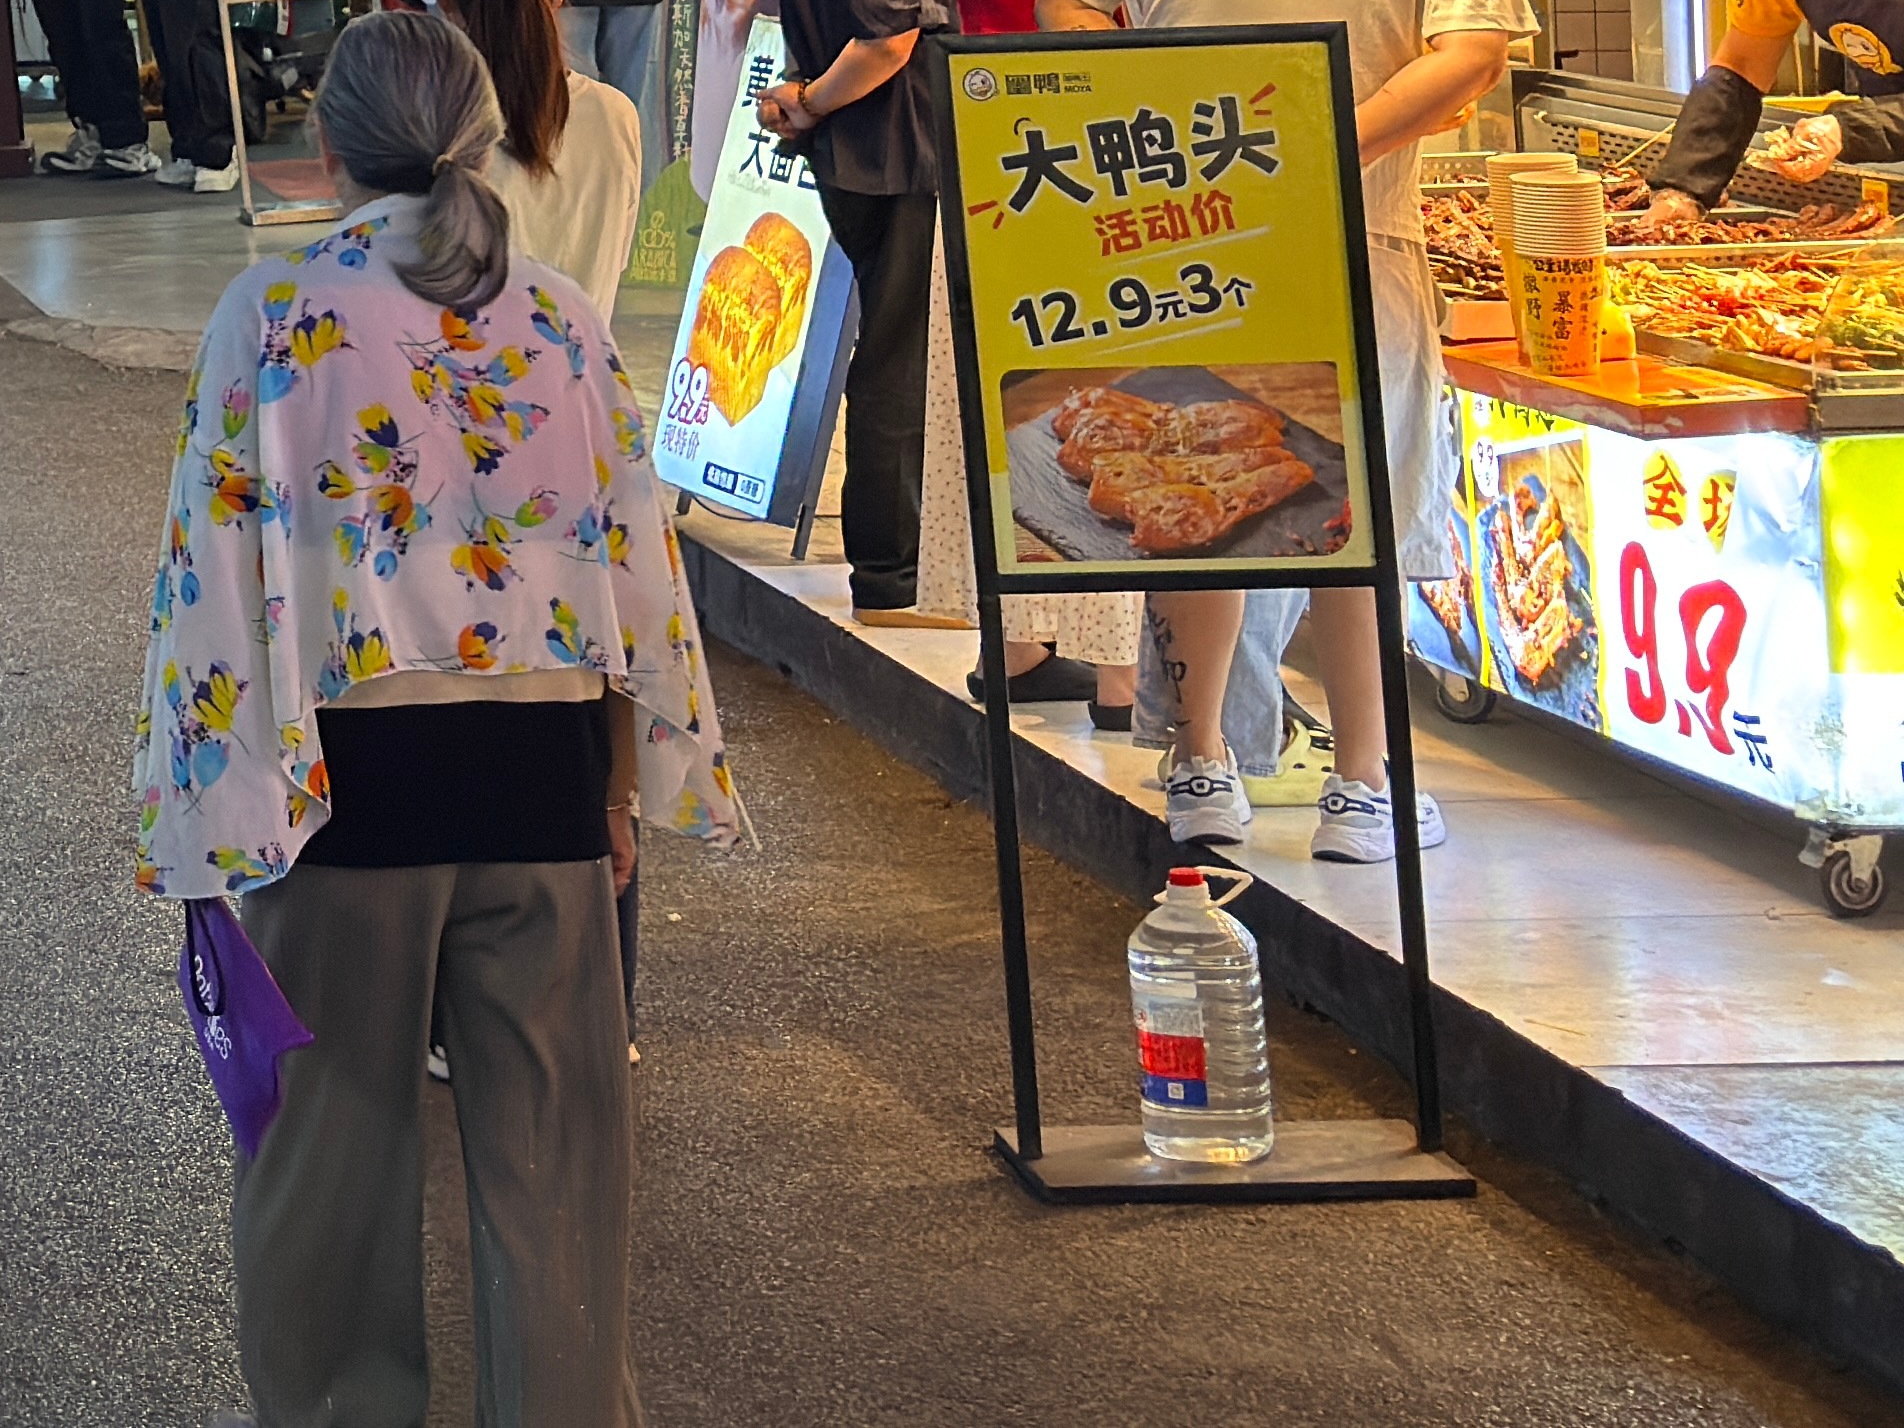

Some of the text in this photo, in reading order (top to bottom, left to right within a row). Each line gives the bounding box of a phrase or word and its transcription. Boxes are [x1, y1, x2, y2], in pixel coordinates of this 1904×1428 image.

[999, 95, 1283, 214] 大鸭头
[1092, 188, 1238, 258] 活动价
[1009, 260, 1254, 348] 12.9元3个
